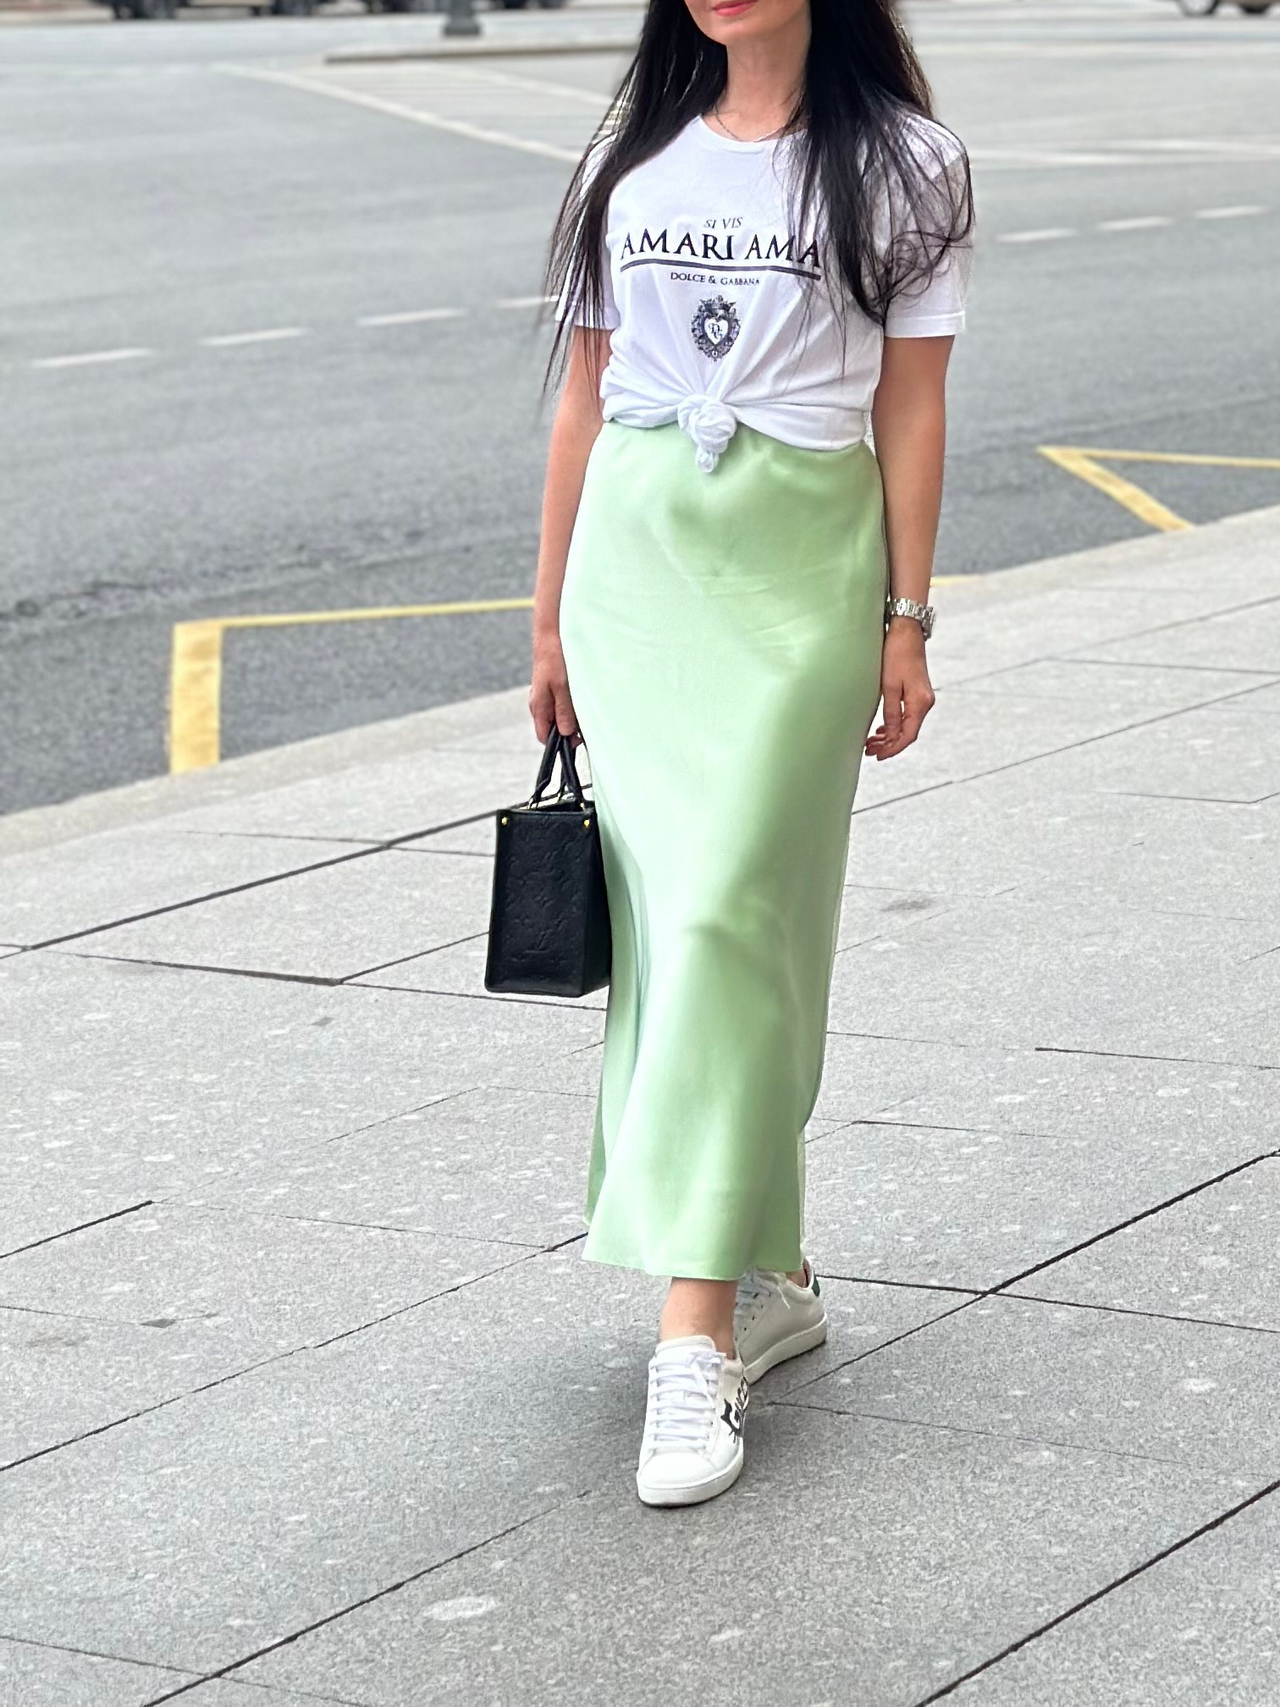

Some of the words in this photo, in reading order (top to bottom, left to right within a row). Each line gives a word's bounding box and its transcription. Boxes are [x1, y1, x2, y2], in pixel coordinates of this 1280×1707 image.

[703, 219, 717, 230] SI
[722, 216, 744, 230] VIS
[620, 228, 735, 261] AMARI
[744, 233, 821, 268] AMA
[670, 271, 706, 283] DOLCE
[708, 275, 717, 285] &
[720, 277, 760, 286] GABBANA
